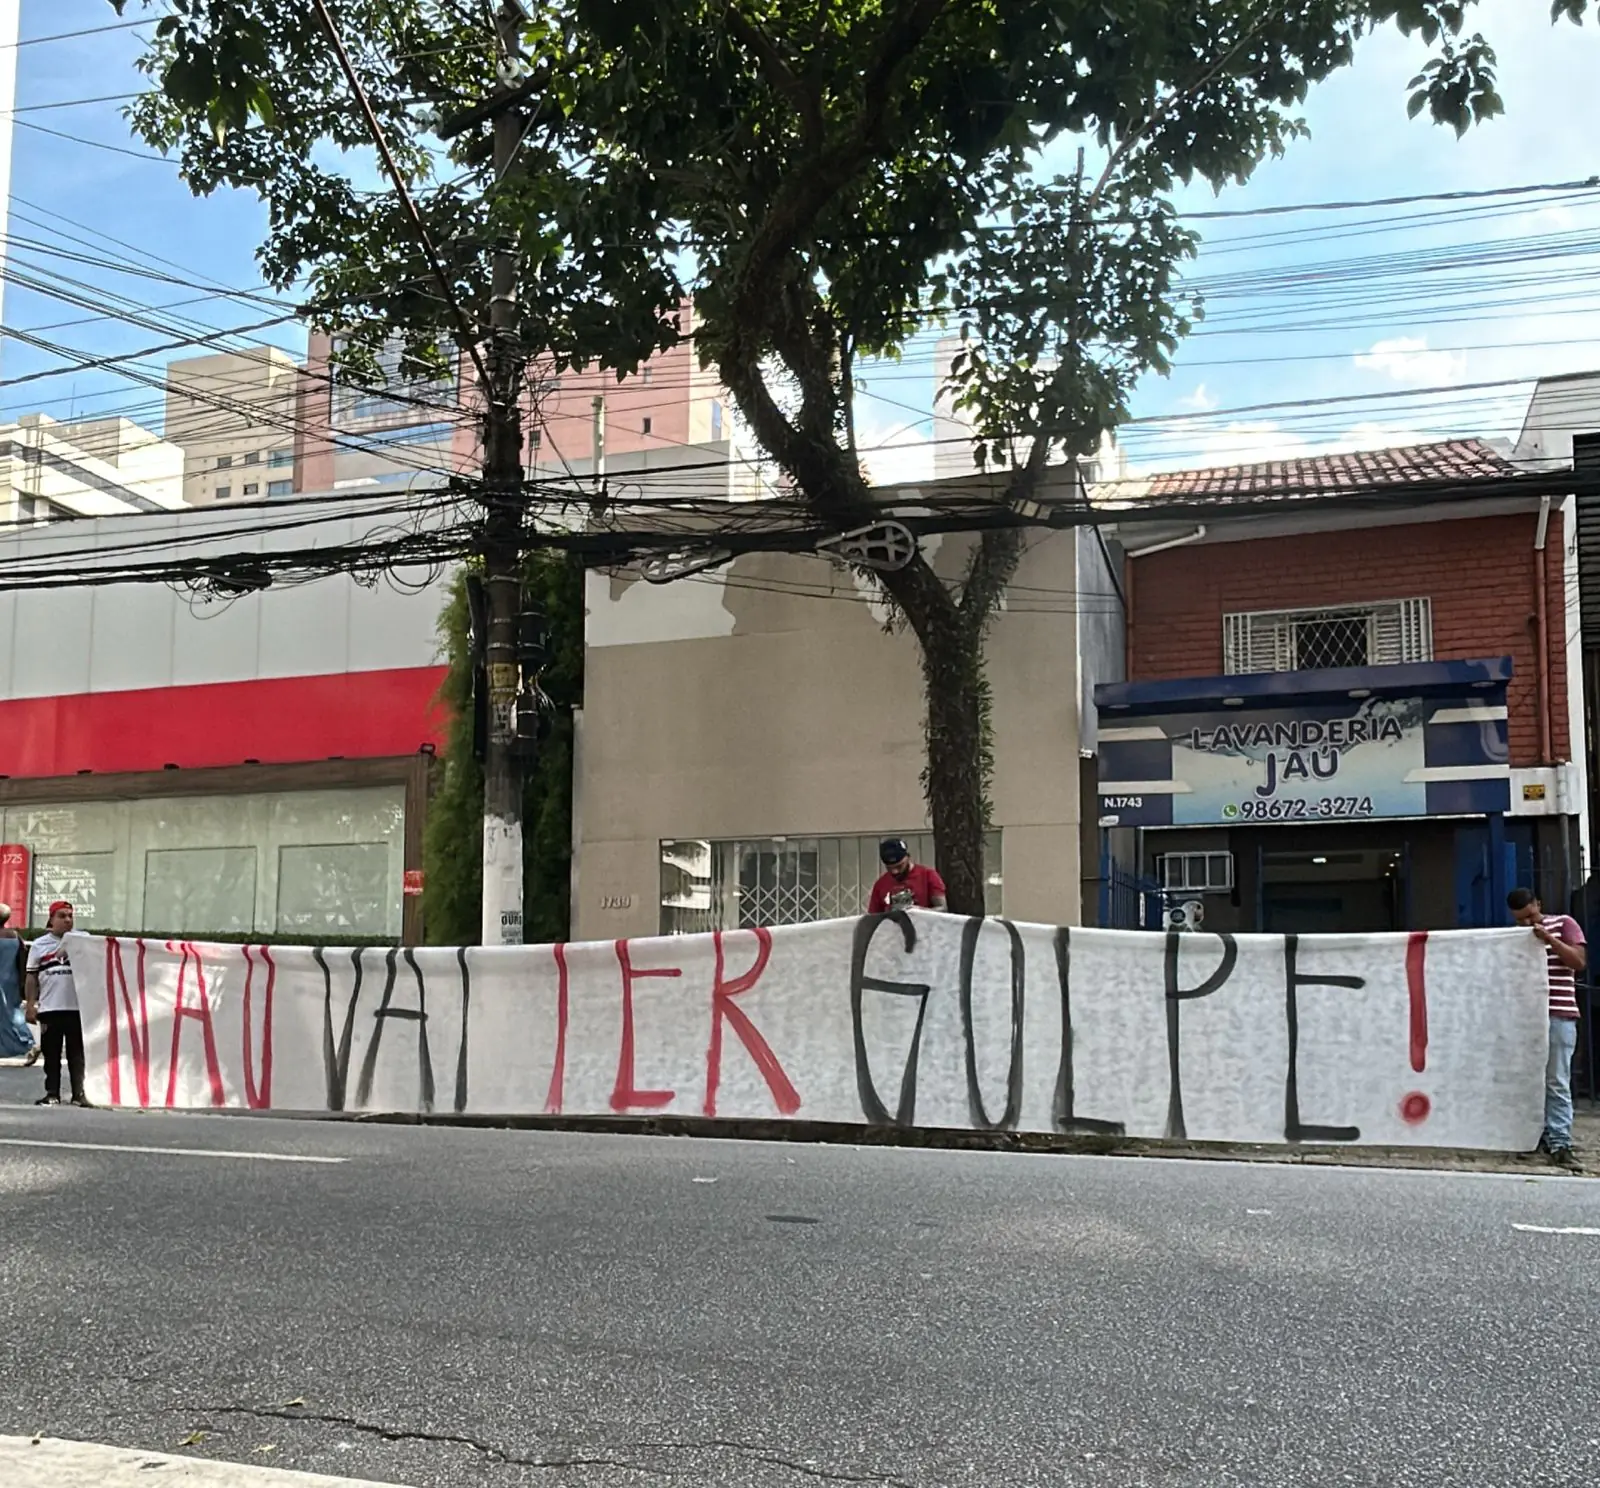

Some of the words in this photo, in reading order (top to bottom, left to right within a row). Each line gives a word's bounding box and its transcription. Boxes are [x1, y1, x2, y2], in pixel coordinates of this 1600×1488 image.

[1192, 716, 1403, 750] LAVANDERIA
[1255, 744, 1339, 797] JAÚ
[1104, 797, 1142, 808] N.1743
[1241, 797, 1374, 819] 98672-3274
[312, 946, 471, 1112] VAI
[850, 909, 1430, 1140] GOLPE!
